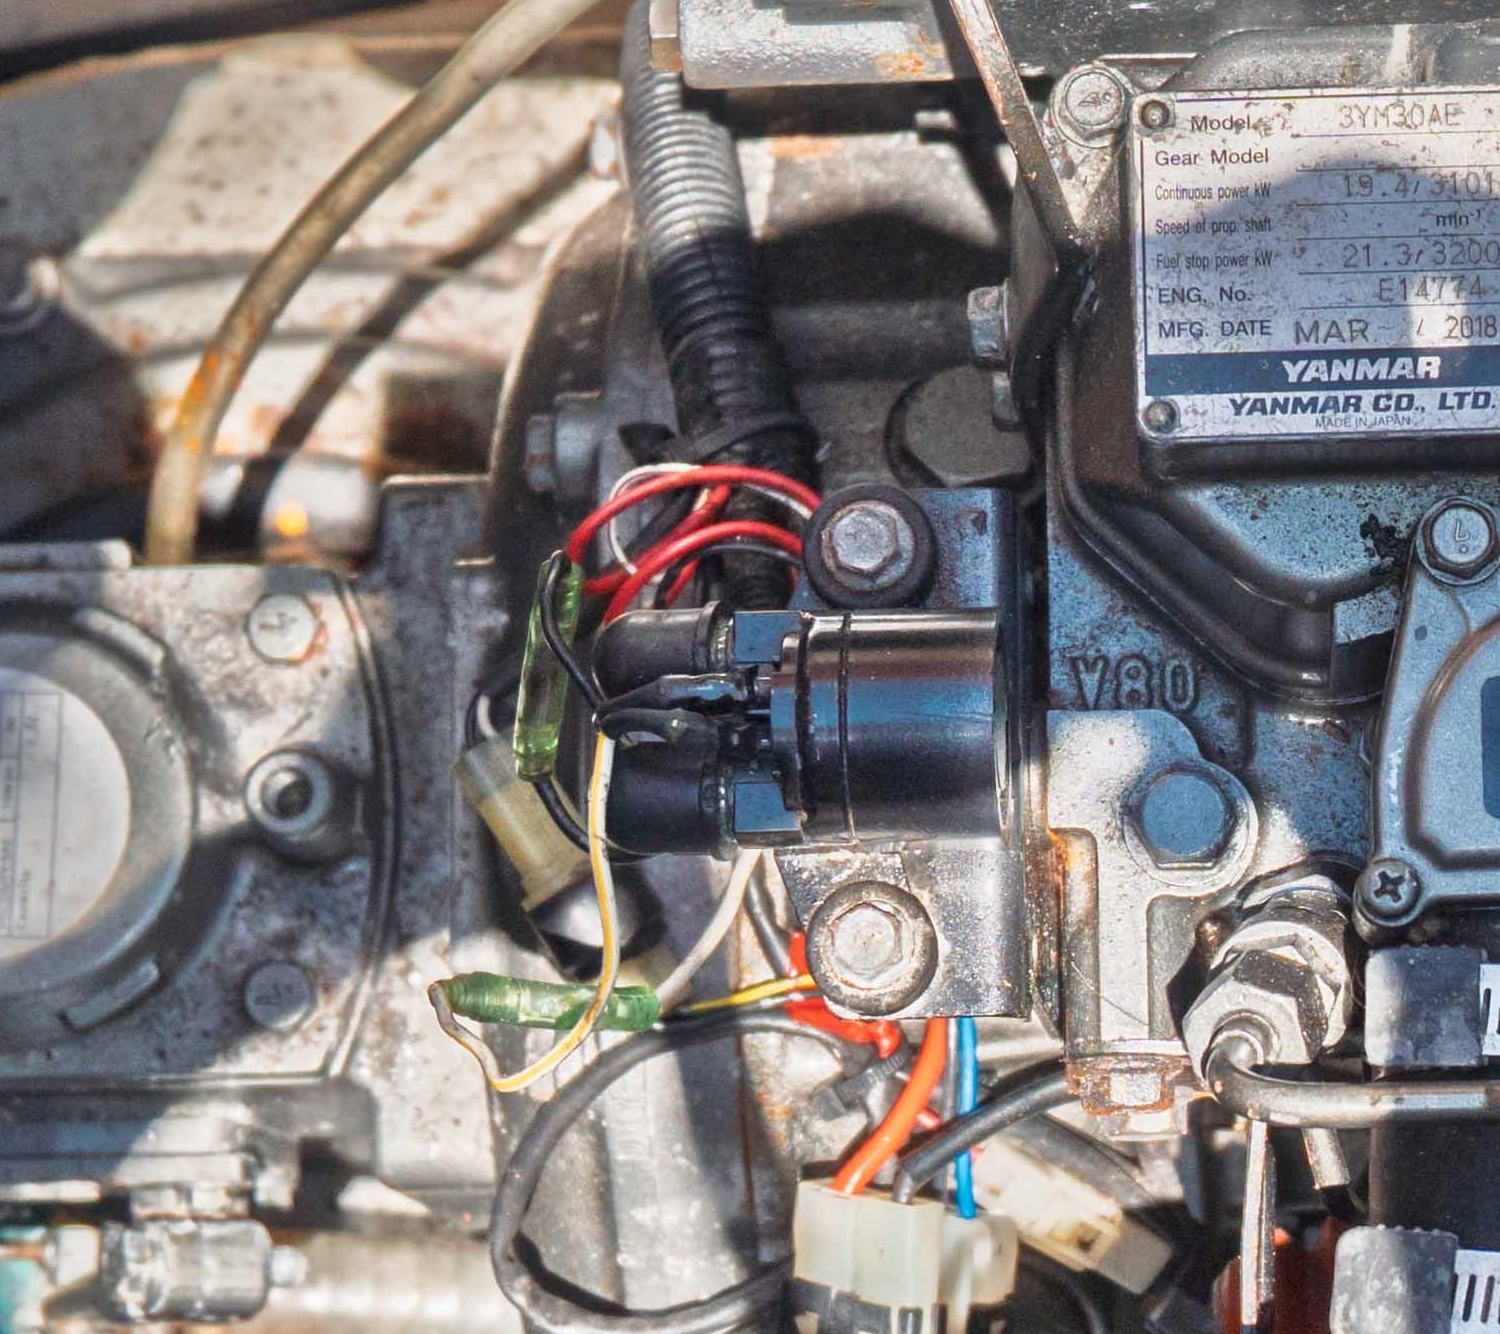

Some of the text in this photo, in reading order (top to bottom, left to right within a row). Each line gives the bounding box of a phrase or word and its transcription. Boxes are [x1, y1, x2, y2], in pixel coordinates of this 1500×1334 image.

[1191, 102, 1461, 131] Model 3YM30AE
[1155, 148, 1269, 166] Gear Model
[1155, 182, 1271, 201] Continuous power kW
[1155, 217, 1272, 236] Speed of prop. shaft
[1156, 251, 1273, 269] Fuel stop power kW
[1158, 275, 1486, 304] ENG. No. E14774
[1158, 321, 1208, 339] MFG.
[1221, 319, 1271, 337] DATE
[1294, 319, 1378, 345] MAR.
[1444, 315, 1498, 339] 2018
[1281, 356, 1442, 383] YANMAR
[1229, 391, 1496, 417] YANMAR CO., LTD.
[1315, 415, 1411, 428] MADE IN JAPAN
